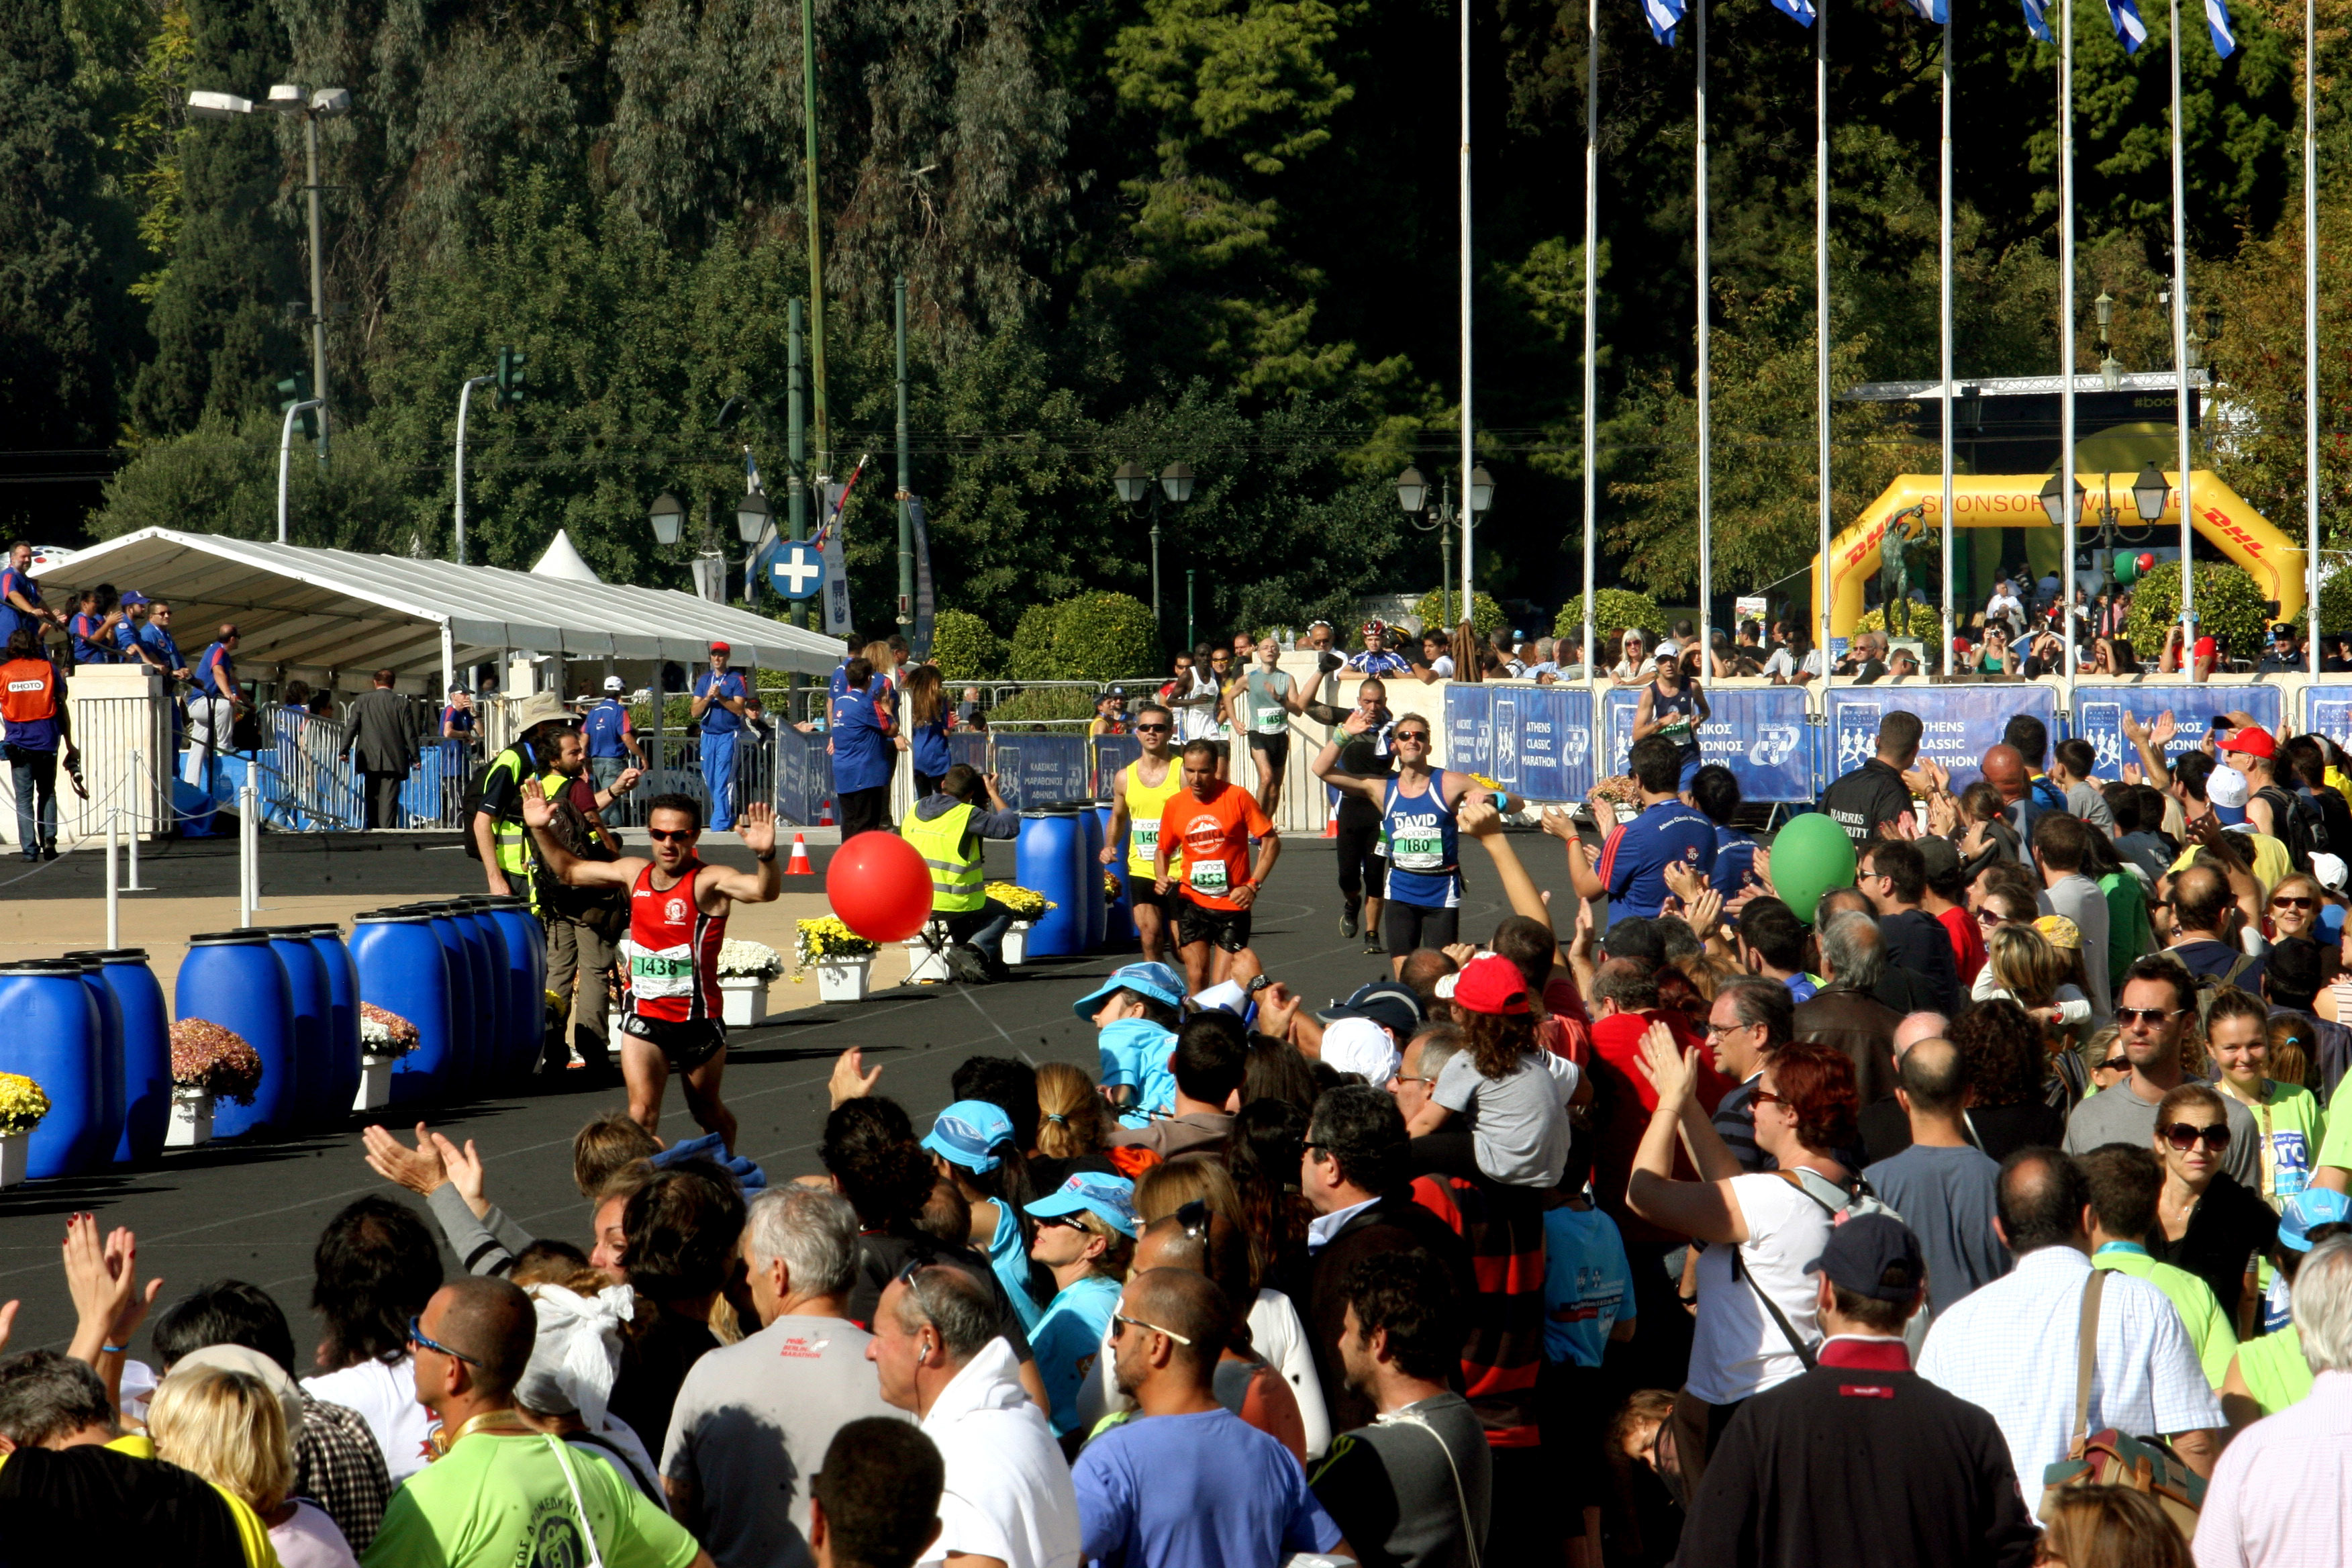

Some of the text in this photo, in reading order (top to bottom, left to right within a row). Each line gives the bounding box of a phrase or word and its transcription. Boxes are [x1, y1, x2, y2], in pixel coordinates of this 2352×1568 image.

[2135, 396, 2179, 407] #boos
[2203, 507, 2264, 558] DHL
[11, 682, 41, 690] PHOTO
[1526, 722, 1551, 733] ATHENS
[1696, 724, 1732, 734] ΣΙΚΟΣ
[1922, 722, 1965, 732] THENS
[1526, 738, 1551, 750] CLASSIC
[1920, 738, 1965, 750] LASSIC
[1521, 754, 1557, 767] MARATHON
[1394, 813, 1437, 830] DAVID
[1830, 808, 1864, 825] HARRIS
[1843, 826, 1869, 838] RITY
[1404, 839, 1430, 852] 1180
[1195, 874, 1222, 885] 1353
[641, 959, 677, 975] 1438
